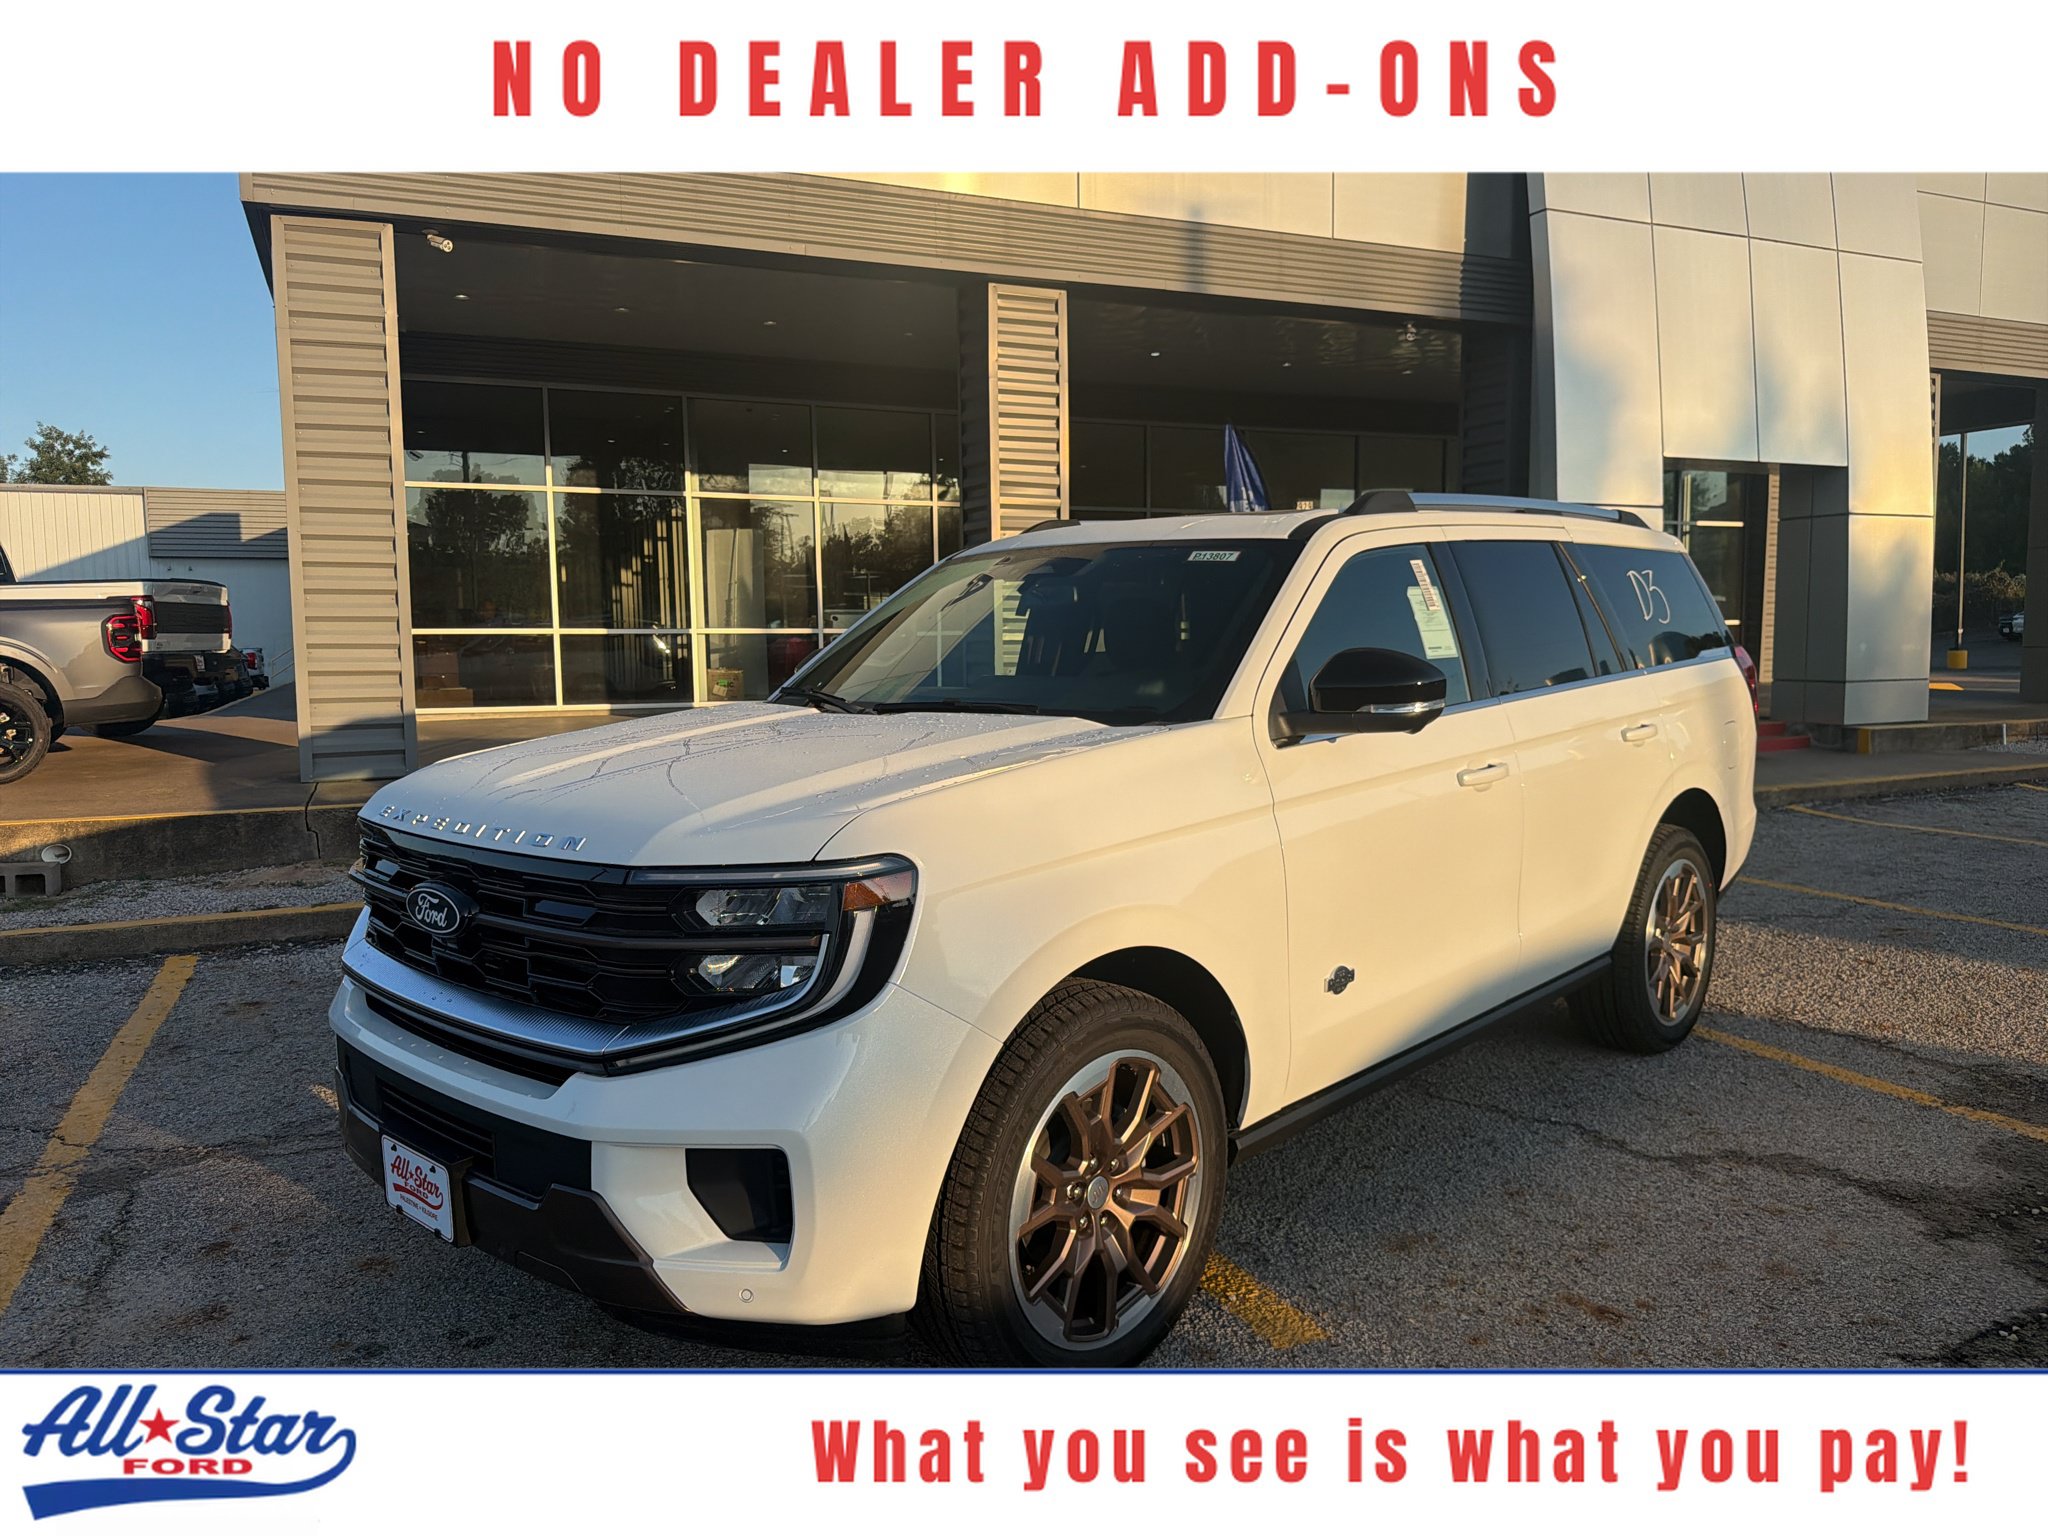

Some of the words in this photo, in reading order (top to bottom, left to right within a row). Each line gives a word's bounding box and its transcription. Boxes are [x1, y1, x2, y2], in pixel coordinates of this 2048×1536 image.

[379, 806, 587, 851] EXPEDITION
[415, 893, 447, 927] Ford
[404, 1181, 429, 1199] FORD
